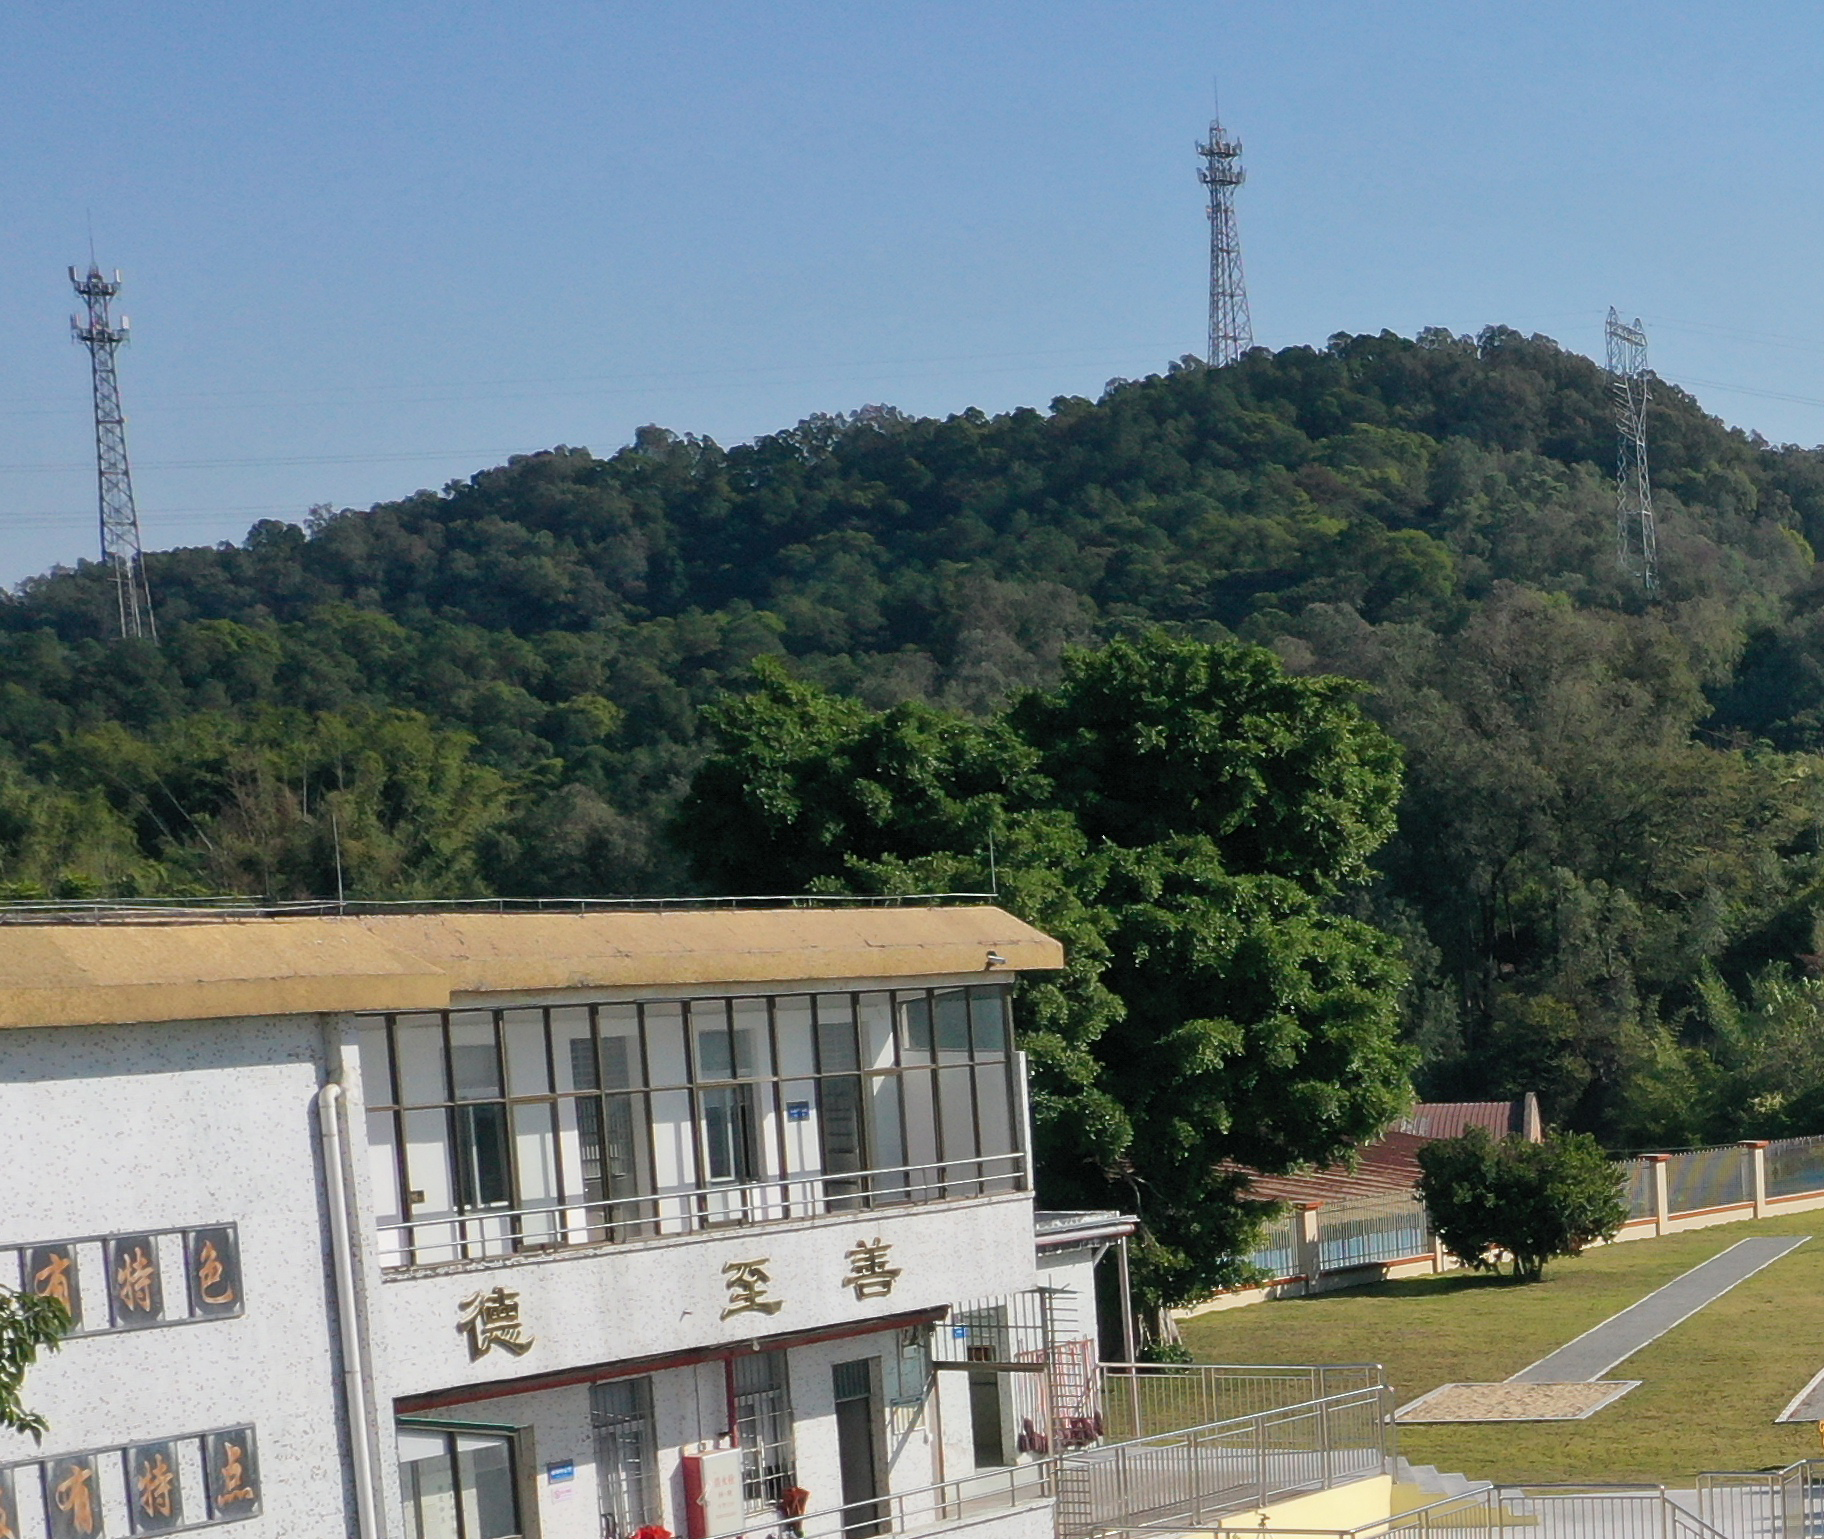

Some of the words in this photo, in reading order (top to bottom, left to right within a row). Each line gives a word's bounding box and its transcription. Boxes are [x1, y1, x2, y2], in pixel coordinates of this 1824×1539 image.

[34, 1239, 234, 1316] 有特色
[457, 1286, 535, 1363] 德
[721, 1237, 902, 1322] 至善
